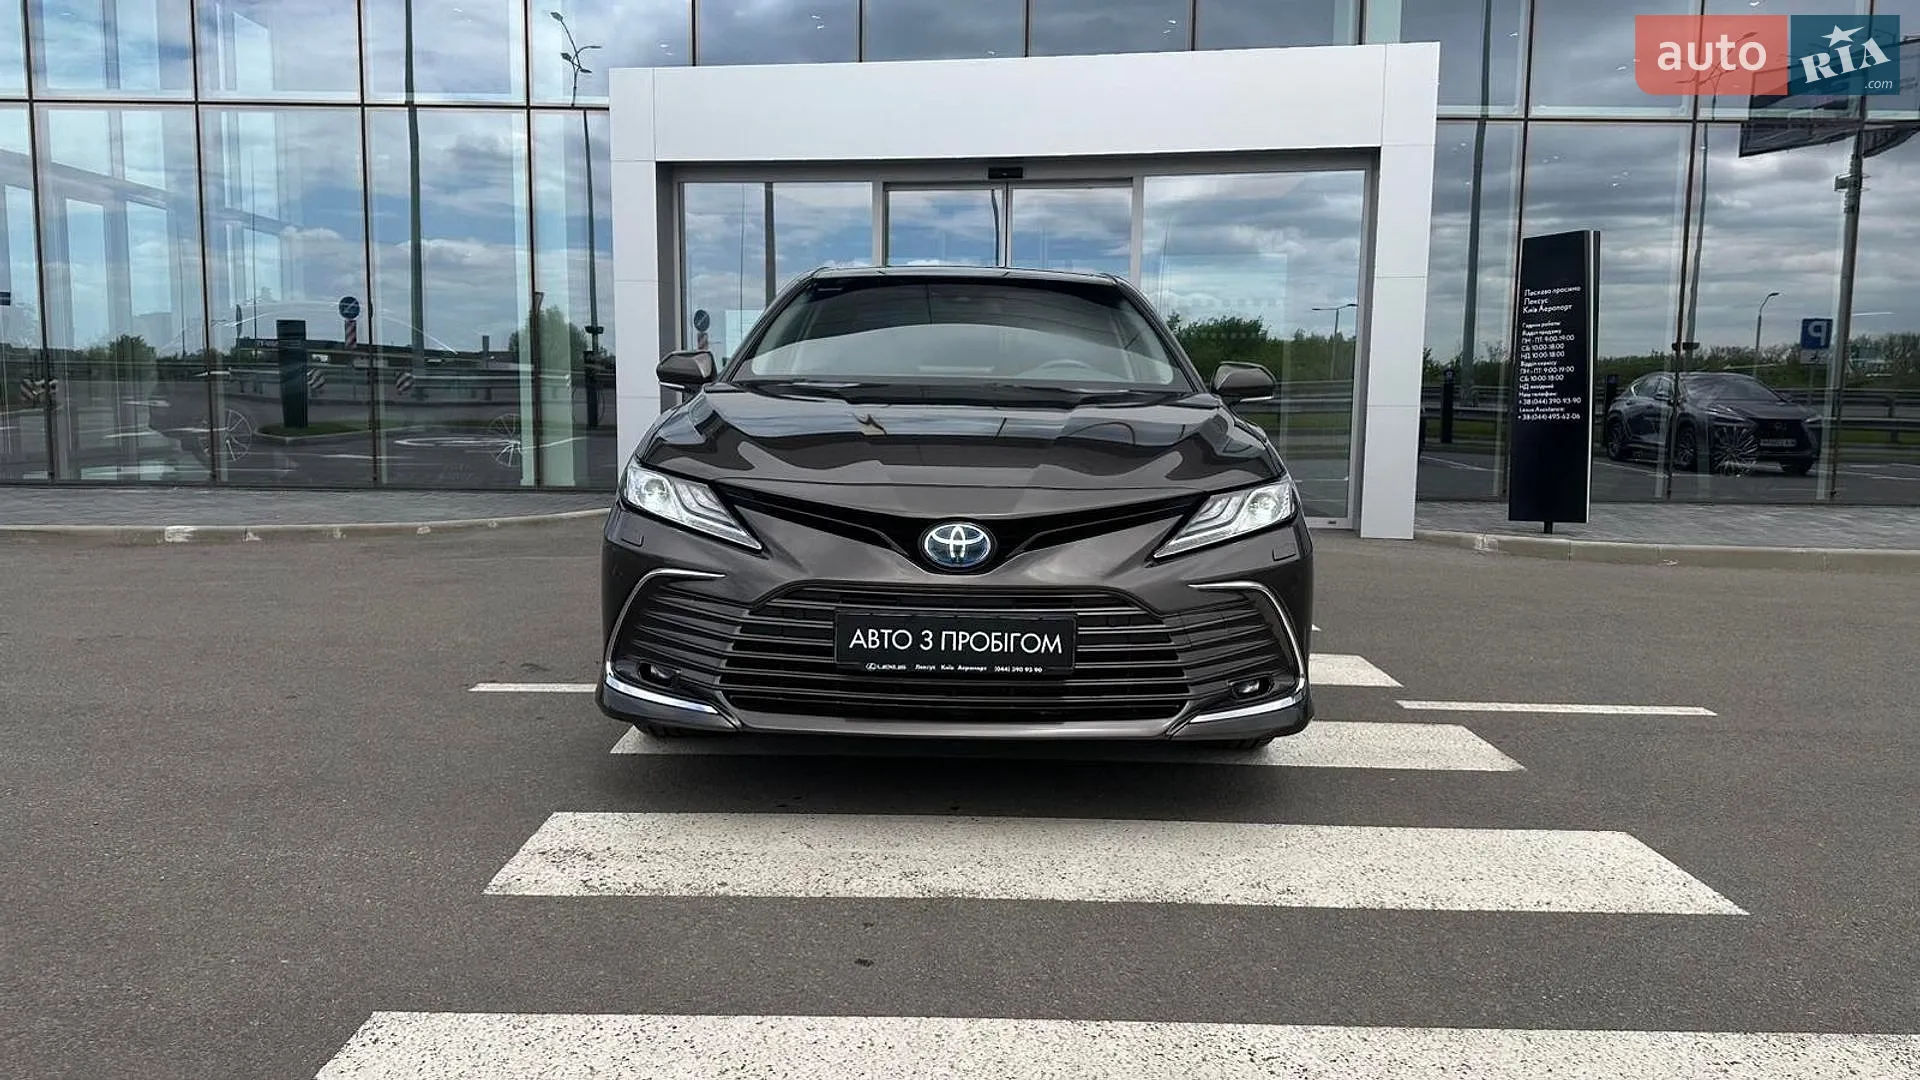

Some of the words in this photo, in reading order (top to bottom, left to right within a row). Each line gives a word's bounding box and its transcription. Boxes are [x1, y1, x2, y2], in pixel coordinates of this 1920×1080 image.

[1523, 297, 1549, 305] Лексус
[1539, 304, 1573, 312] Аеропорт
[849, 629, 913, 650] АВТО
[920, 630, 934, 651] З
[941, 631, 1063, 654] ПРОБІГОМ
